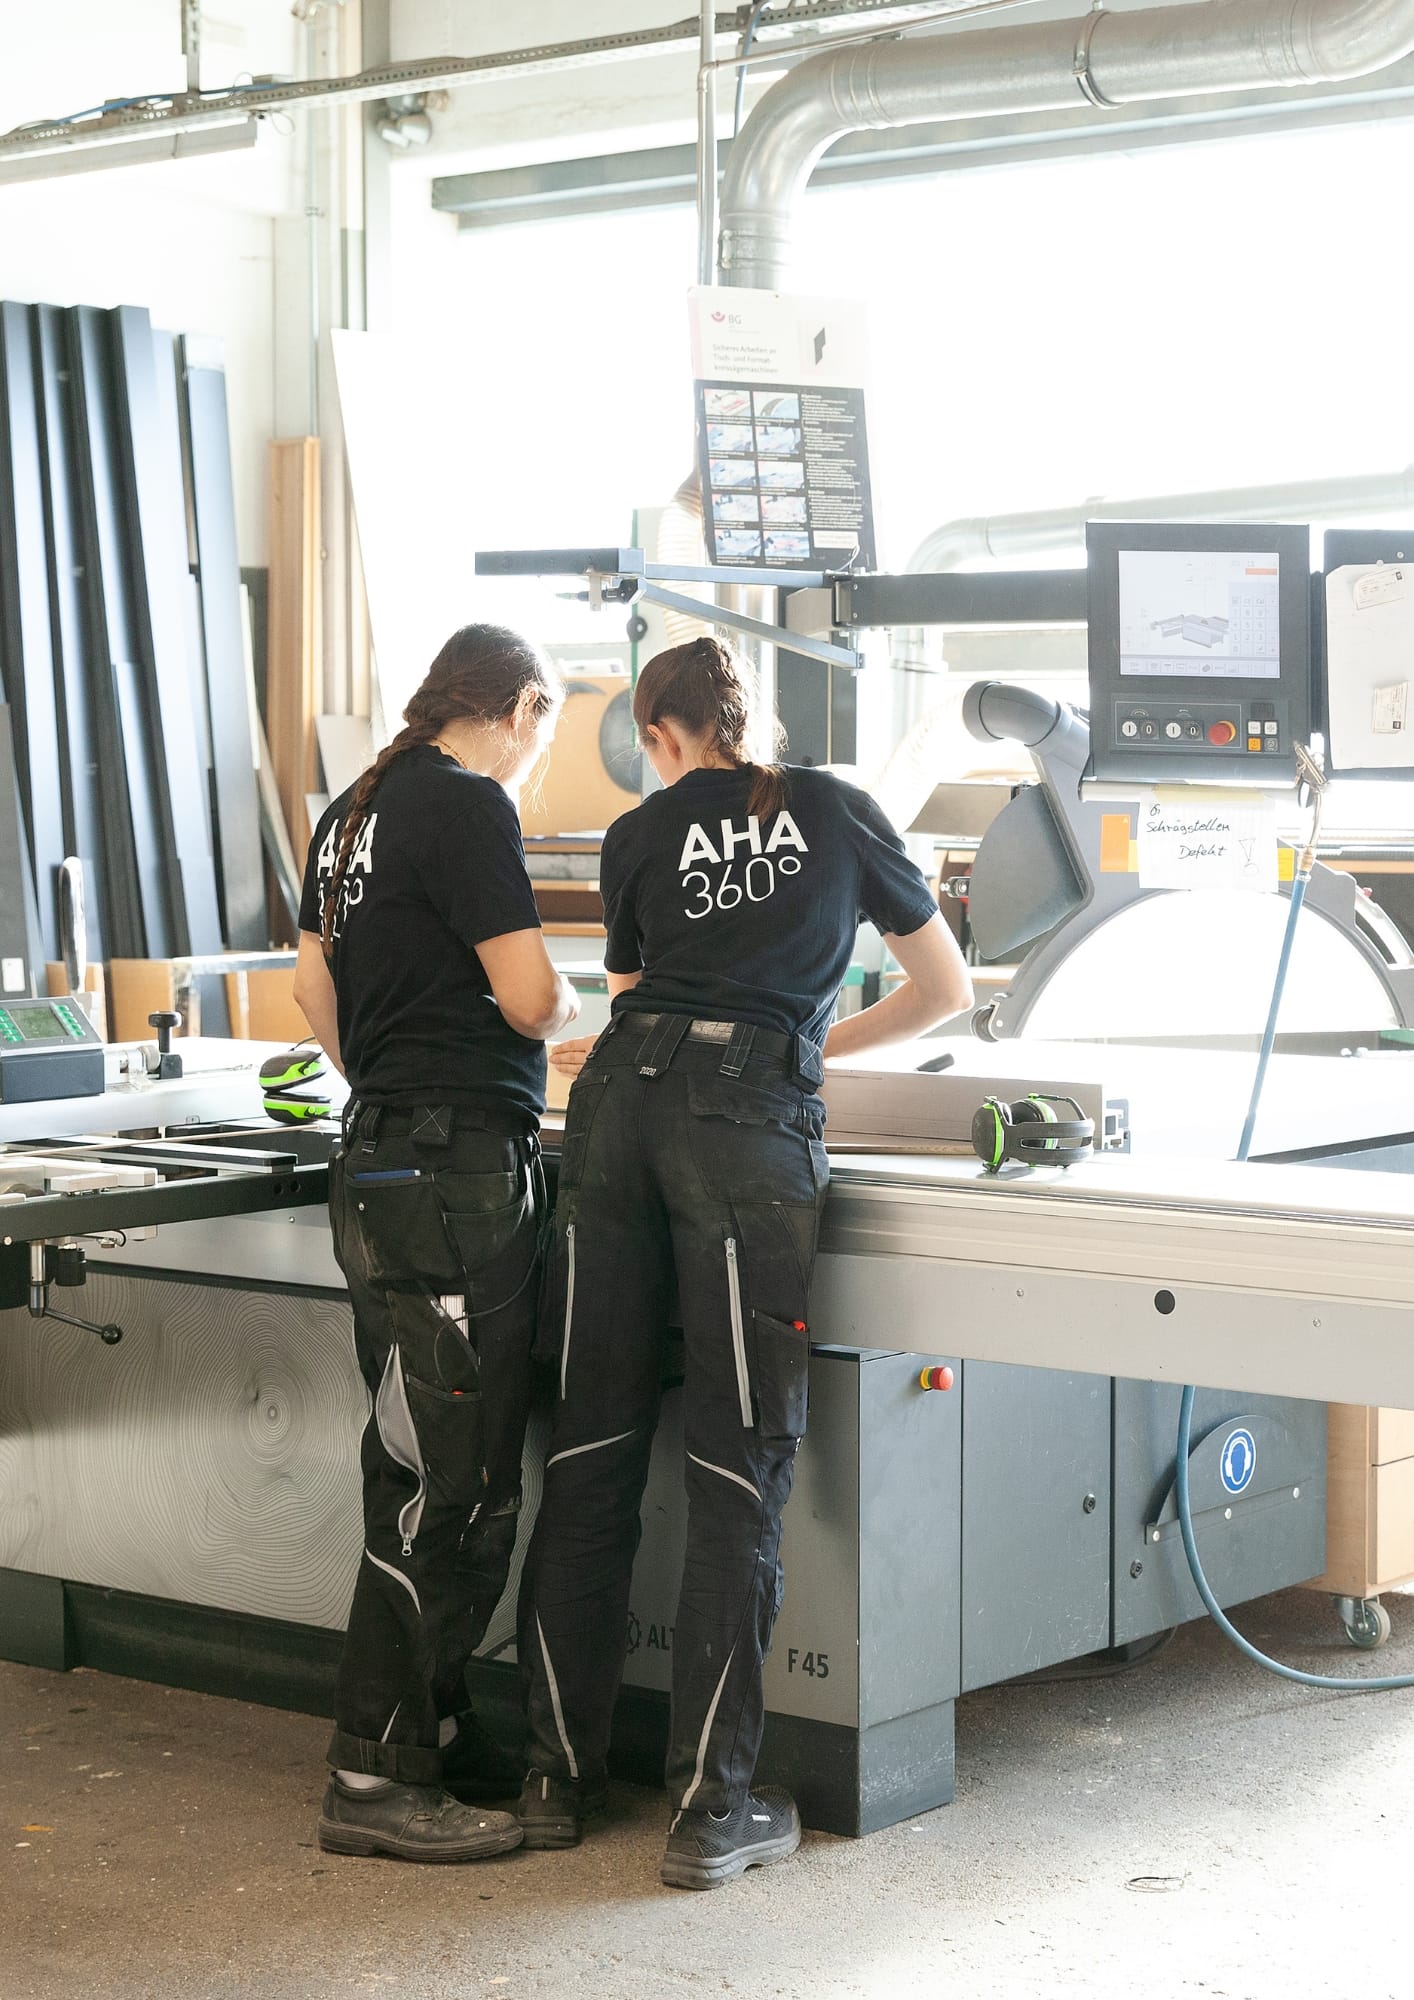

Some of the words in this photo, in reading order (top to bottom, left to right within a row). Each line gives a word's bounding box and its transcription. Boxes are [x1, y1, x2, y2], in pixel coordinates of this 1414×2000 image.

[728, 314, 742, 325] BG
[678, 810, 809, 872] AHA
[1178, 844, 1228, 859] Defekt
